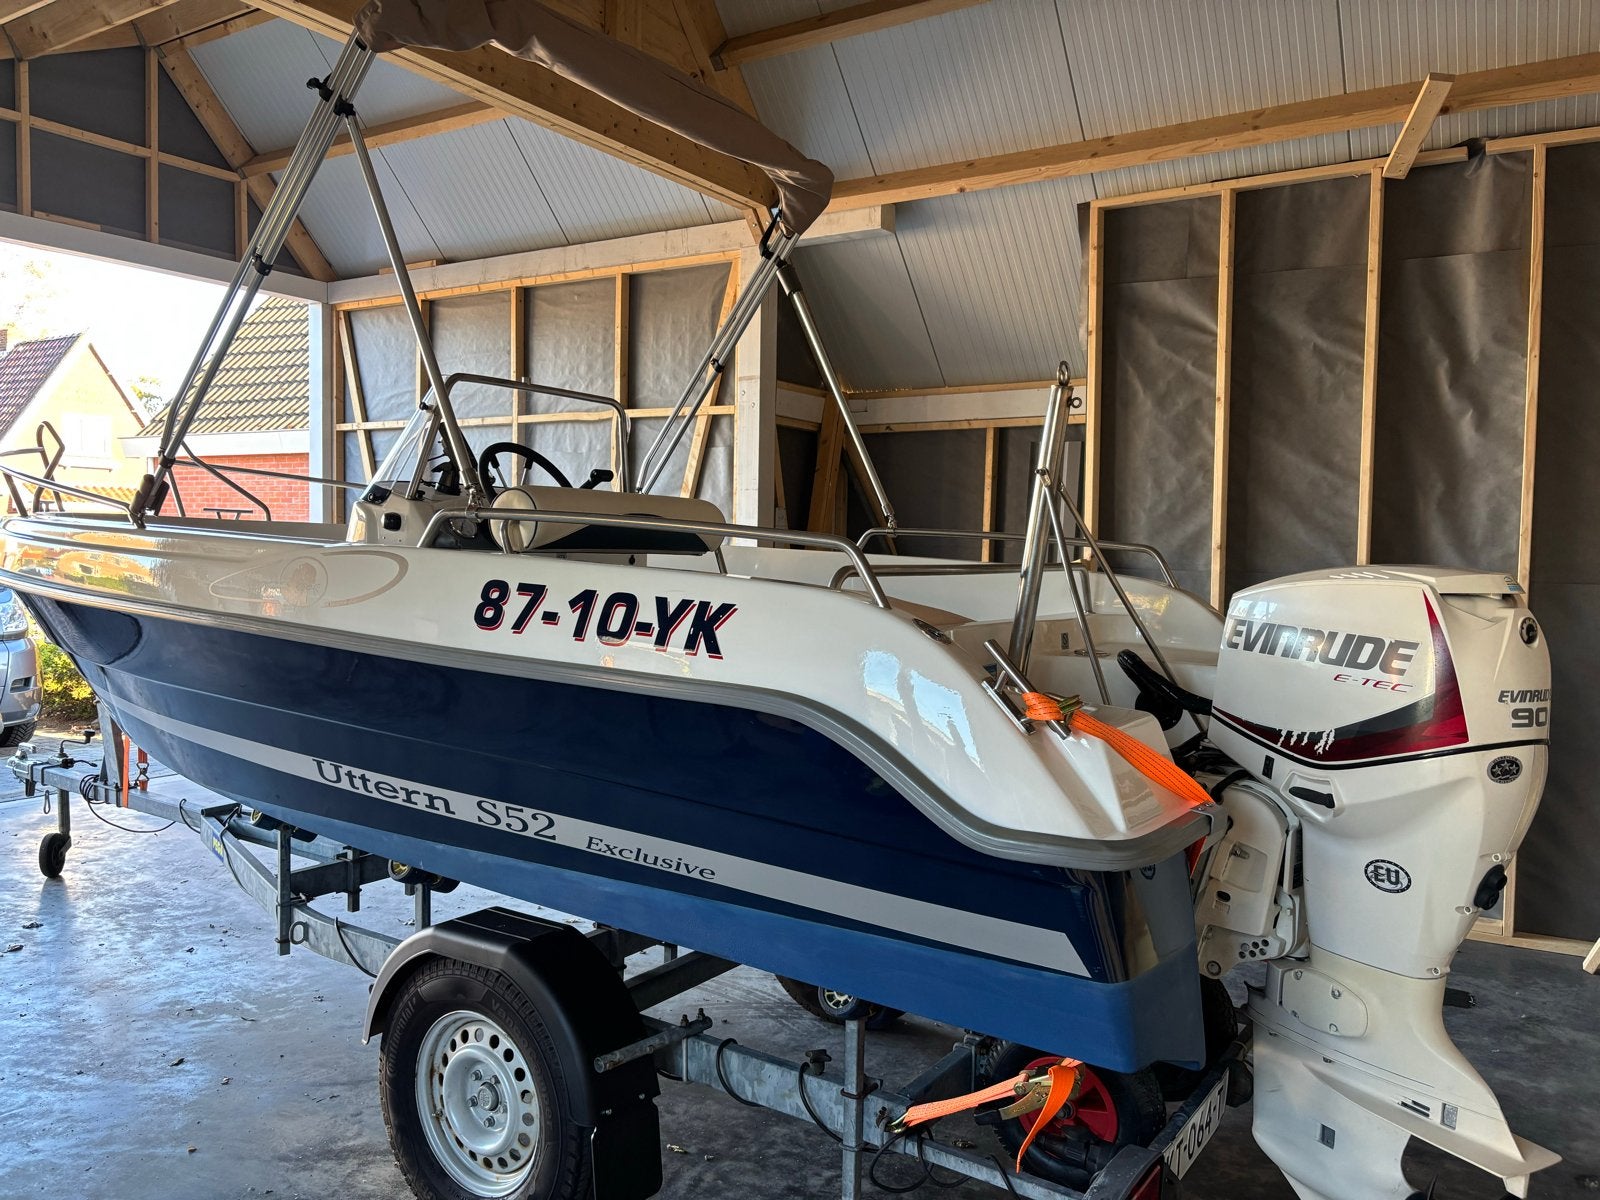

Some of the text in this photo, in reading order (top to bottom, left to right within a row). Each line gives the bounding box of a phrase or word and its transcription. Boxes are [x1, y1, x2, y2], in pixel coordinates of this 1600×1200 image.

[474, 579, 737, 660] 87-10-YK
[1226, 619, 1420, 676] EVINRUDE
[1333, 673, 1414, 693] E-TEC
[1498, 689, 1551, 703] EVINRUD
[1511, 707, 1548, 728] 90
[312, 757, 716, 880] Uttern S52 Exclusive
[1373, 865, 1400, 885] EU
